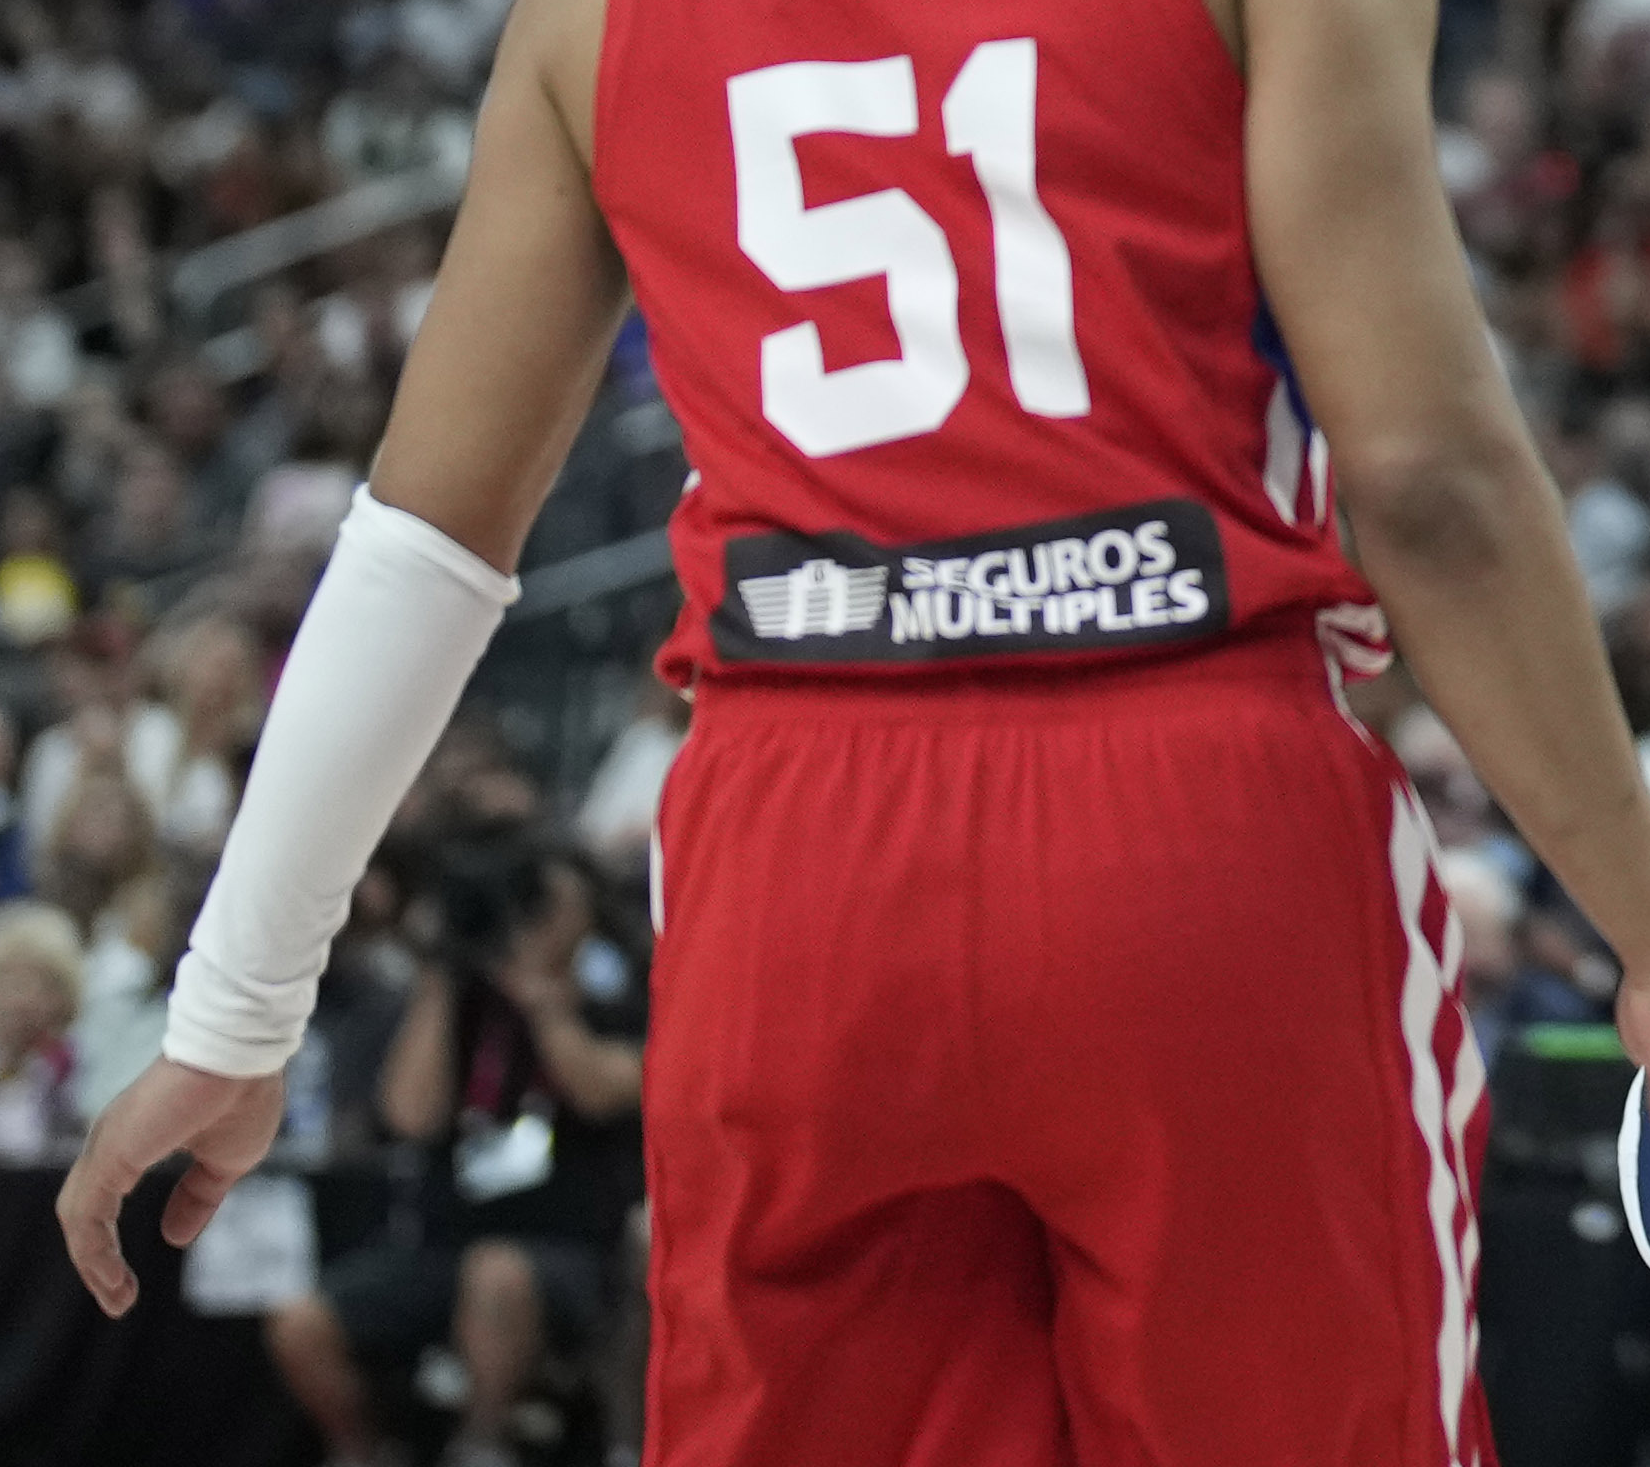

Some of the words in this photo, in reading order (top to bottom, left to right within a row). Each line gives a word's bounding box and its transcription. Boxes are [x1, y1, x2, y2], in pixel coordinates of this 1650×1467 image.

[727, 36, 1092, 459] 51
[901, 520, 1177, 598] SEGUROS
[888, 568, 1210, 645] MULTIPLES
